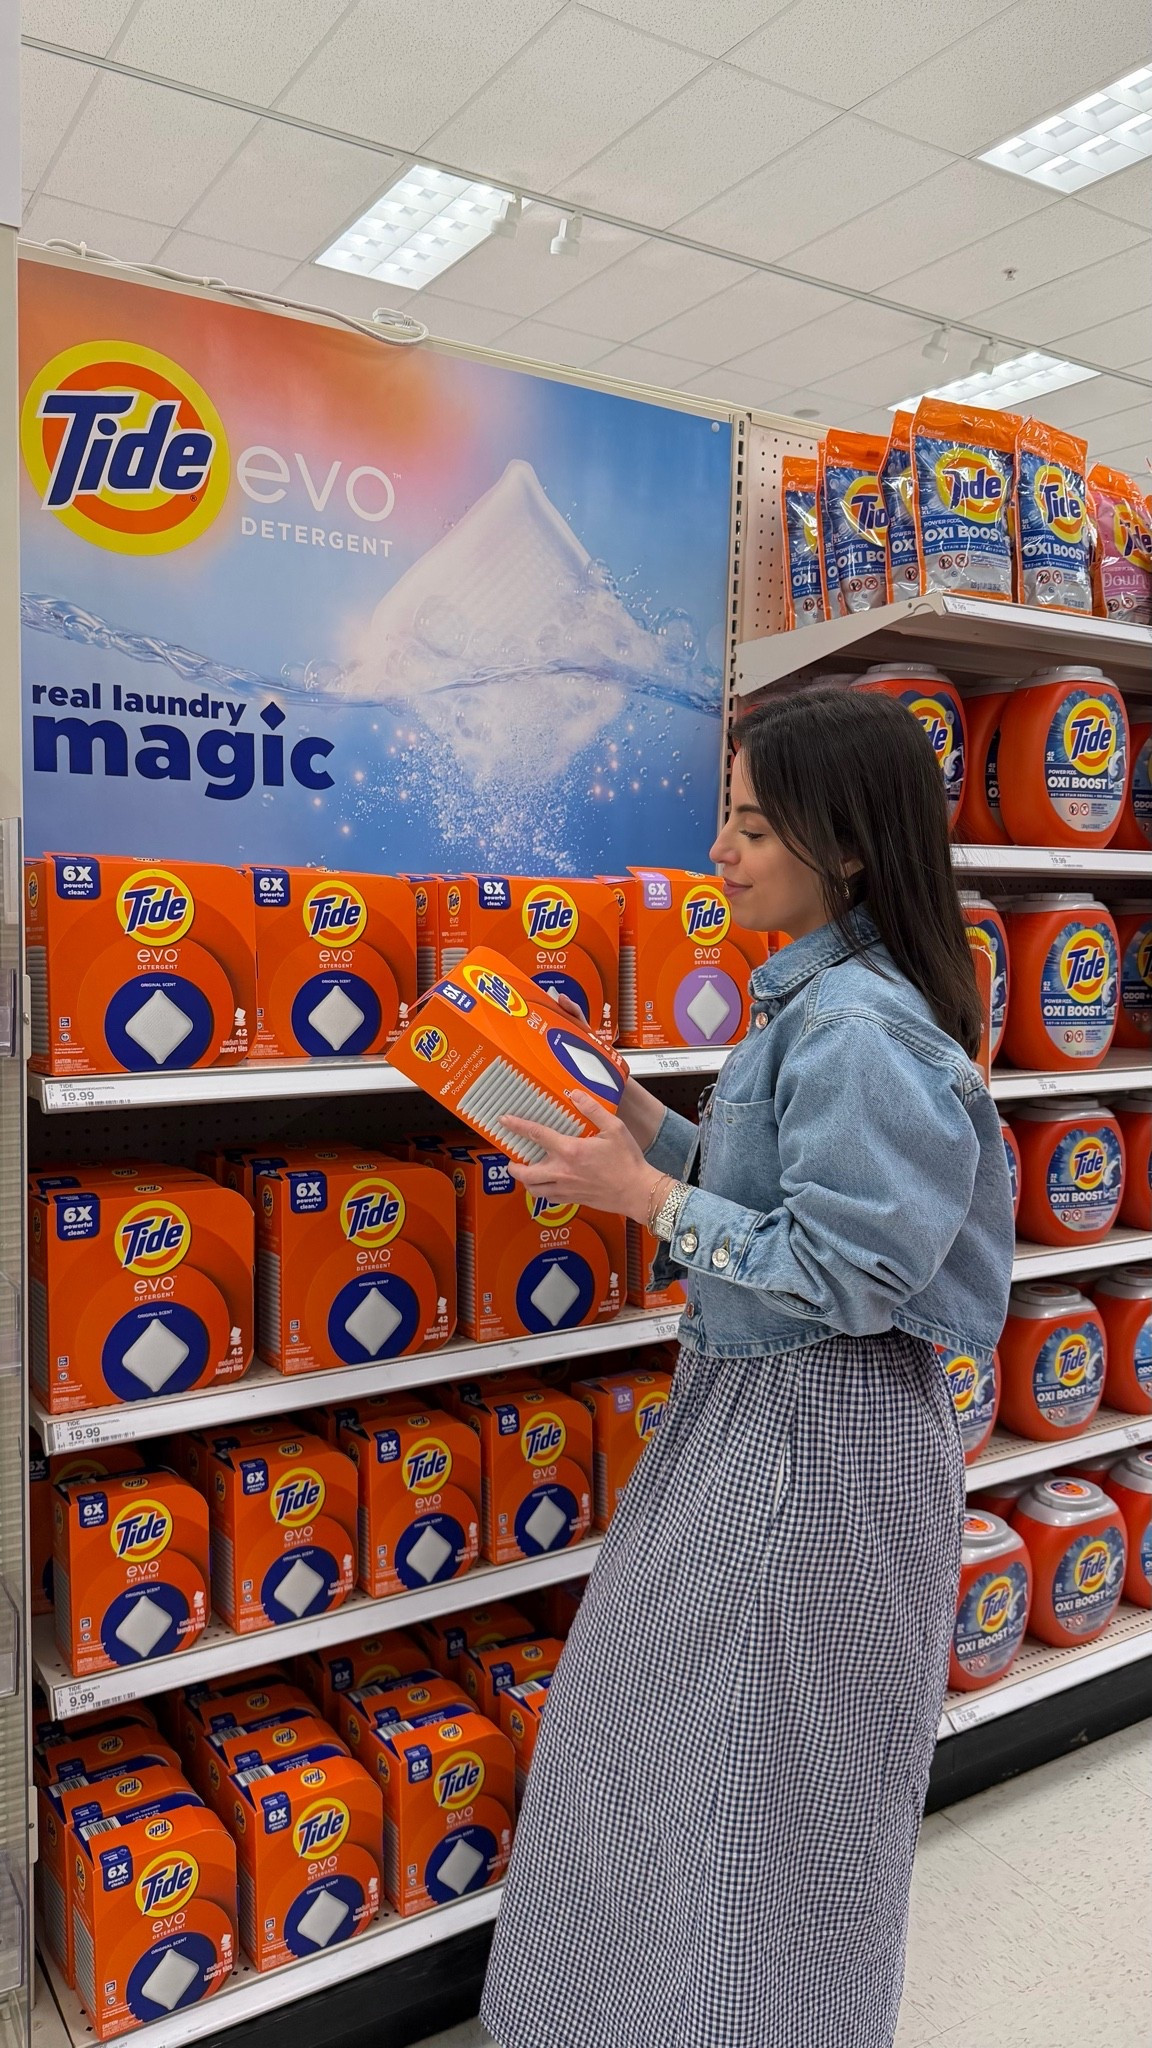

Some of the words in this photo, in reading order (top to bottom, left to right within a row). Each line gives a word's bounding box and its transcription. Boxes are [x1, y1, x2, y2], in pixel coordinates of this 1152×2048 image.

[36, 390, 215, 512] Tide
[236, 444, 396, 523] evo
[942, 467, 1002, 510] Tide
[923, 519, 946, 527] POWER
[241, 517, 394, 558] DETERGENT
[924, 526, 955, 542] OXI
[837, 551, 863, 568] OXI
[1023, 542, 1052, 557] OXI
[1053, 543, 1085, 562] BOOST
[32, 683, 102, 711] real
[112, 685, 247, 727] laundry
[1070, 717, 1113, 762] Tide
[32, 702, 336, 801] magic
[1047, 776, 1070, 789] OXI
[1071, 777, 1108, 790] BOOST
[62, 865, 93, 882] 6X
[63, 882, 94, 890] powerful
[259, 877, 285, 892] 6X
[483, 881, 505, 895] 6X
[648, 883, 667, 896] 6X
[259, 891, 285, 899] powerful
[447, 892, 460, 912] Tide
[123, 886, 188, 935] Tide
[308, 895, 362, 938] Tide
[685, 898, 726, 938] Tide
[527, 900, 574, 939] Tide
[136, 949, 178, 963] evo
[318, 950, 353, 963] evo
[536, 951, 567, 963] evo
[694, 947, 721, 960] evo
[1065, 947, 1106, 990] Tide
[443, 985, 462, 1001] 6X
[477, 972, 513, 1016] Tide
[1043, 1005, 1065, 1017] OXI
[1067, 1005, 1101, 1017] BOOST
[235, 1028, 248, 1037] 42
[415, 1028, 442, 1063] Tide
[440, 1049, 458, 1070] evo
[658, 1060, 680, 1068] 19.99
[439, 1080, 455, 1096] 100%
[453, 1043, 484, 1081] concentrated
[451, 1069, 474, 1096] Powerful
[61, 1091, 95, 1102] 19.99
[488, 1165, 509, 1180] 6X
[1073, 1148, 1104, 1181] Tide
[296, 1181, 321, 1198] 6X
[1050, 1193, 1070, 1203] OXI
[1071, 1190, 1103, 1202] BOOST
[296, 1197, 322, 1205] powerful
[63, 1205, 93, 1223] 6X
[346, 1192, 400, 1240] Tide
[63, 1221, 93, 1231] powerful
[121, 1215, 184, 1268] Tide
[540, 1227, 570, 1242] evo
[355, 1248, 391, 1265] evo
[356, 1263, 391, 1271] DETERGENT
[133, 1276, 175, 1295] evo
[134, 1291, 175, 1302] DETERGENT
[137, 1311, 158, 1319] ORIGINAL
[158, 1309, 173, 1317] SCENT
[438, 1315, 449, 1323] 42
[231, 1346, 244, 1356] 42
[1059, 1345, 1087, 1378] Tide
[617, 1393, 631, 1404] 6X
[1036, 1392, 1055, 1402] OXI
[1056, 1386, 1087, 1400] BOOST
[501, 1413, 517, 1426] 6X
[69, 1427, 101, 1441] 19.99
[381, 1441, 397, 1452] 6X
[525, 1423, 562, 1463] Tide
[246, 1471, 265, 1484] 6X
[406, 1449, 448, 1491] Tide
[532, 1465, 557, 1480] evo
[124, 1478, 147, 1488] Tide
[83, 1501, 104, 1515] 6X
[275, 1479, 321, 1524] Tide
[415, 1493, 442, 1509] evo
[116, 1511, 168, 1559] Tide
[284, 1525, 314, 1542] evo
[126, 1560, 160, 1578] evo
[1077, 1553, 1108, 1588] Tide
[126, 1573, 160, 1584] DETERGENT
[981, 1587, 1010, 1627] Tide
[1054, 1600, 1074, 1613] OXI
[1075, 1591, 1105, 1608] BOOST
[957, 1641, 977, 1655] OXI
[978, 1631, 1008, 1648] BOOST
[495, 1673, 511, 1687] 6X
[68, 1684, 81, 1693] TIDE
[69, 1692, 95, 1707] 9.99
[275, 1730, 297, 1745] Tide
[441, 1724, 461, 1740] Tide
[411, 1758, 428, 1772] 6X
[303, 1769, 325, 1785] Tide
[118, 1779, 141, 1794] Tide
[437, 1763, 479, 1808] Tide
[268, 1807, 287, 1823] 6X
[446, 1805, 474, 1826] evo
[148, 1820, 171, 1837] Tide
[298, 1809, 346, 1858] Tide
[107, 1862, 128, 1879] 6X
[307, 1854, 338, 1876] evo
[107, 1874, 129, 1887] powerful
[307, 1866, 338, 1881] DETERGENT
[141, 1862, 194, 1916] Tide
[152, 1909, 186, 1934] evo
[152, 1924, 186, 1940] DETERGENT
[223, 1950, 232, 1959] 16
